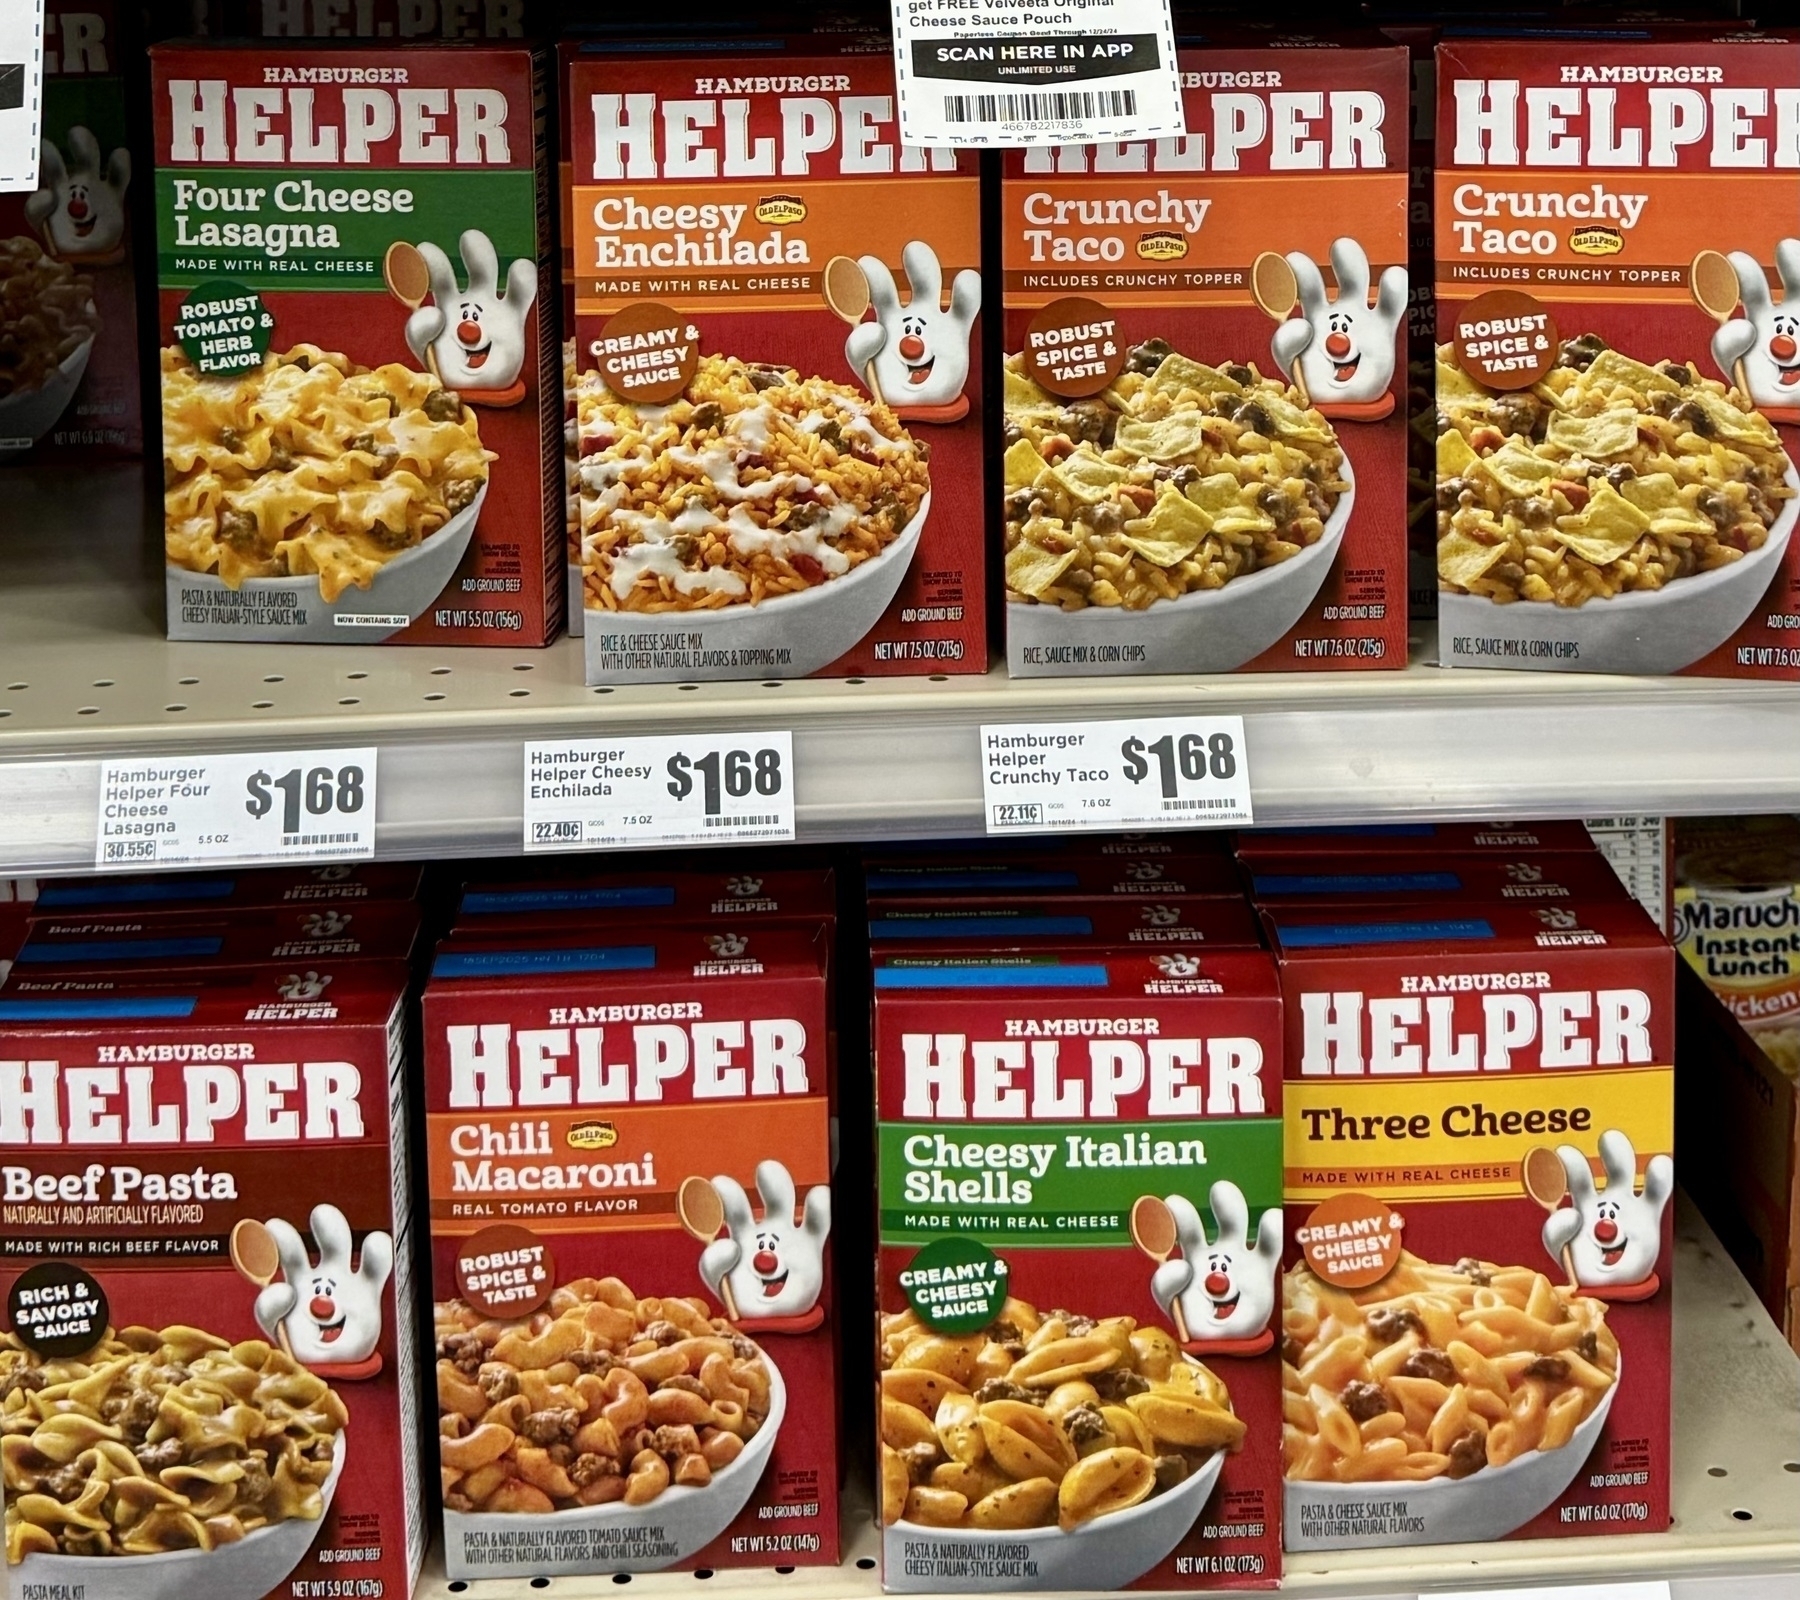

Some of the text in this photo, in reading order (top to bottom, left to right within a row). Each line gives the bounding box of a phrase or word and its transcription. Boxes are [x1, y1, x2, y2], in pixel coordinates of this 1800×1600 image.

[908, 0, 932, 13] get
[910, 12, 1072, 27] Cheese Sauce Pouch
[937, 43, 1133, 62] SCAN HERE IN APP
[263, 67, 408, 83] HAMBURGER
[998, 65, 1076, 75] UNLIMITED USE
[695, 75, 850, 94] HAMBURGER
[168, 79, 511, 164] HELPER
[1001, 120, 1083, 131] 466782217836
[173, 179, 413, 213] Four Cheese
[593, 196, 748, 238] Cheesy
[1023, 190, 1212, 234] Crunchy
[175, 214, 339, 256] Lasagna
[1023, 231, 1125, 261] Taco
[595, 229, 810, 268] Enchilada
[1023, 274, 1242, 287] INCLUDES CRUNCHY TOPPER
[1023, 645, 1145, 664] RICE, SAUCE MIX & CORN CHIPS
[988, 733, 1084, 751] Hamburger
[989, 751, 1046, 770] Helper
[1121, 732, 1236, 799] $168
[107, 766, 206, 784] Hamburger
[990, 768, 1109, 788] Crunchy Taco
[106, 782, 210, 803] Helper Four
[245, 765, 364, 833] $168
[1082, 799, 1111, 808] 7.6 OZ
[105, 802, 168, 817] Cheese
[104, 819, 176, 839] Lasagna
[1696, 933, 1800, 956] Instant
[1708, 954, 1789, 977] Lunch
[1301, 989, 1652, 1075] HELPER
[98, 1043, 255, 1063] HAMBURGER
[0, 1060, 365, 1144] HELPER
[1302, 1104, 1592, 1141] Three Cheese
[450, 1121, 553, 1157] Chili
[903, 1132, 1207, 1178] Cheesy Italian
[2, 1164, 238, 1202] Beef Pasta
[452, 1152, 657, 1192] Macaroni
[904, 1171, 1033, 1204] Shells
[4, 1205, 204, 1225] NATURALLY AND ARTIFICIALLY FLAVORED
